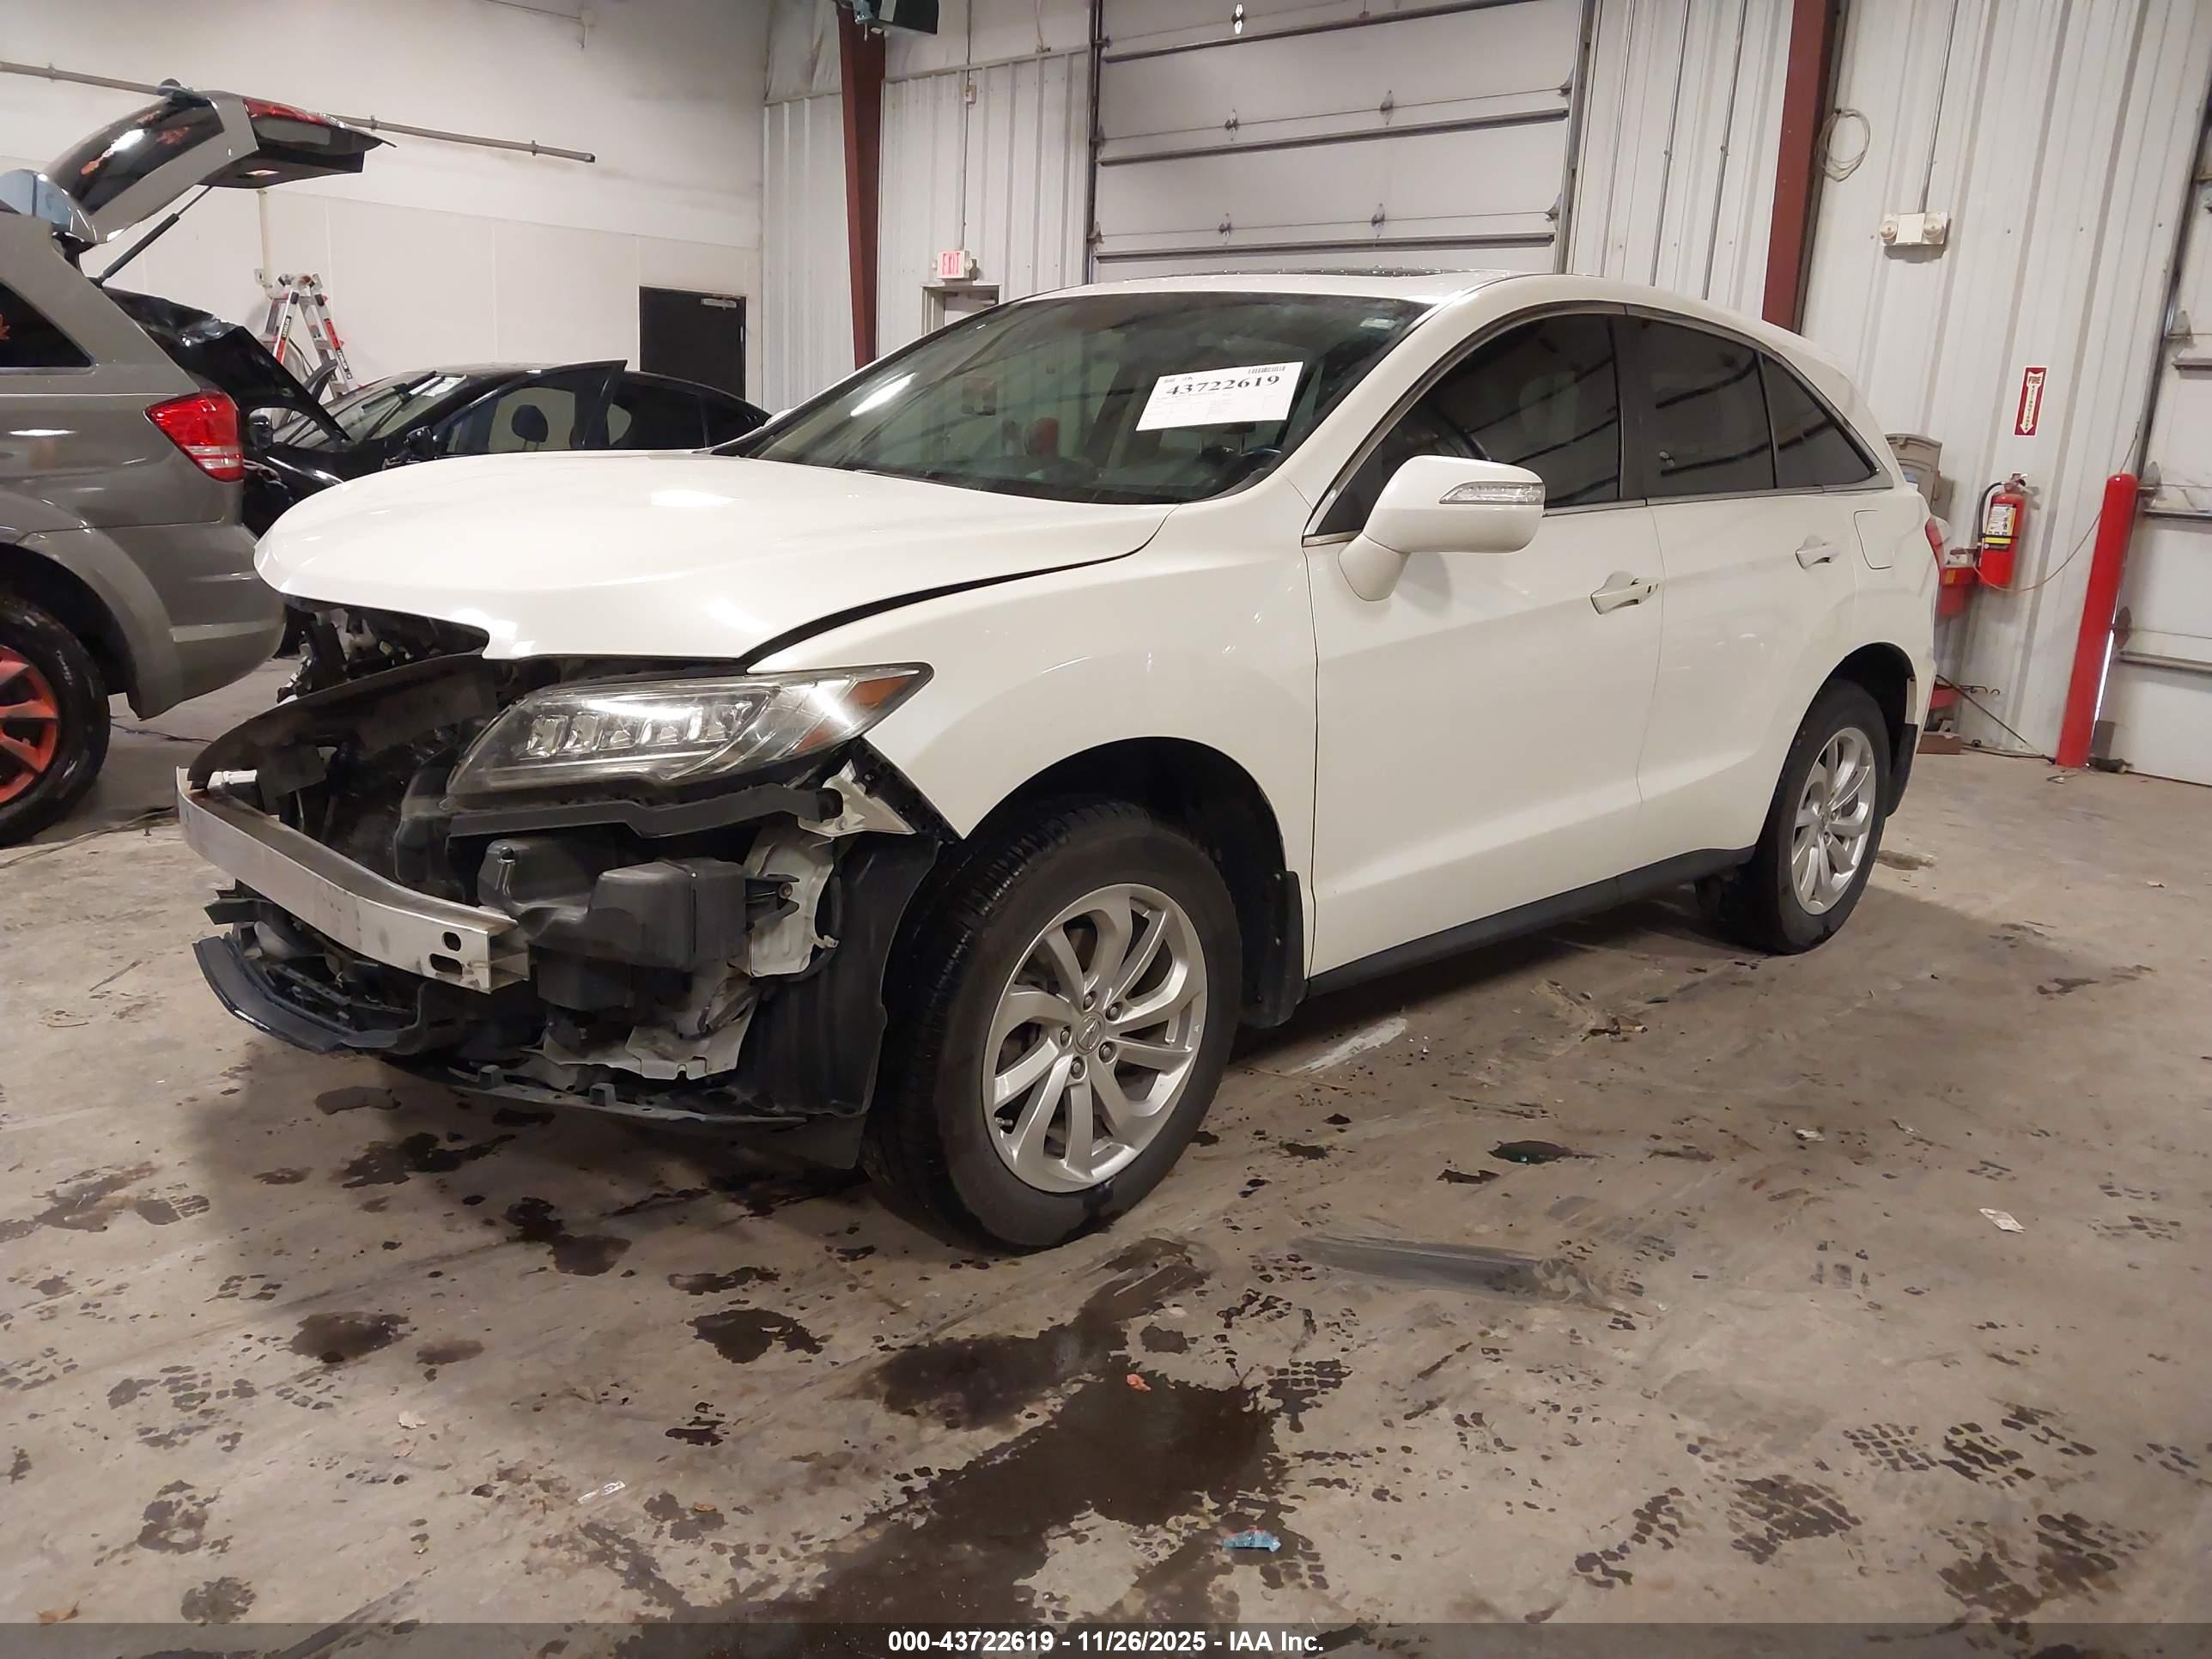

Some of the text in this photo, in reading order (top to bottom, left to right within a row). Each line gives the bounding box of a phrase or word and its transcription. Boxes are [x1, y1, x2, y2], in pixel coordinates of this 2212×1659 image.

[942, 252, 961, 275] EXIT
[1165, 374, 1280, 396] 43722619
[2028, 375, 2042, 385] FIRE
